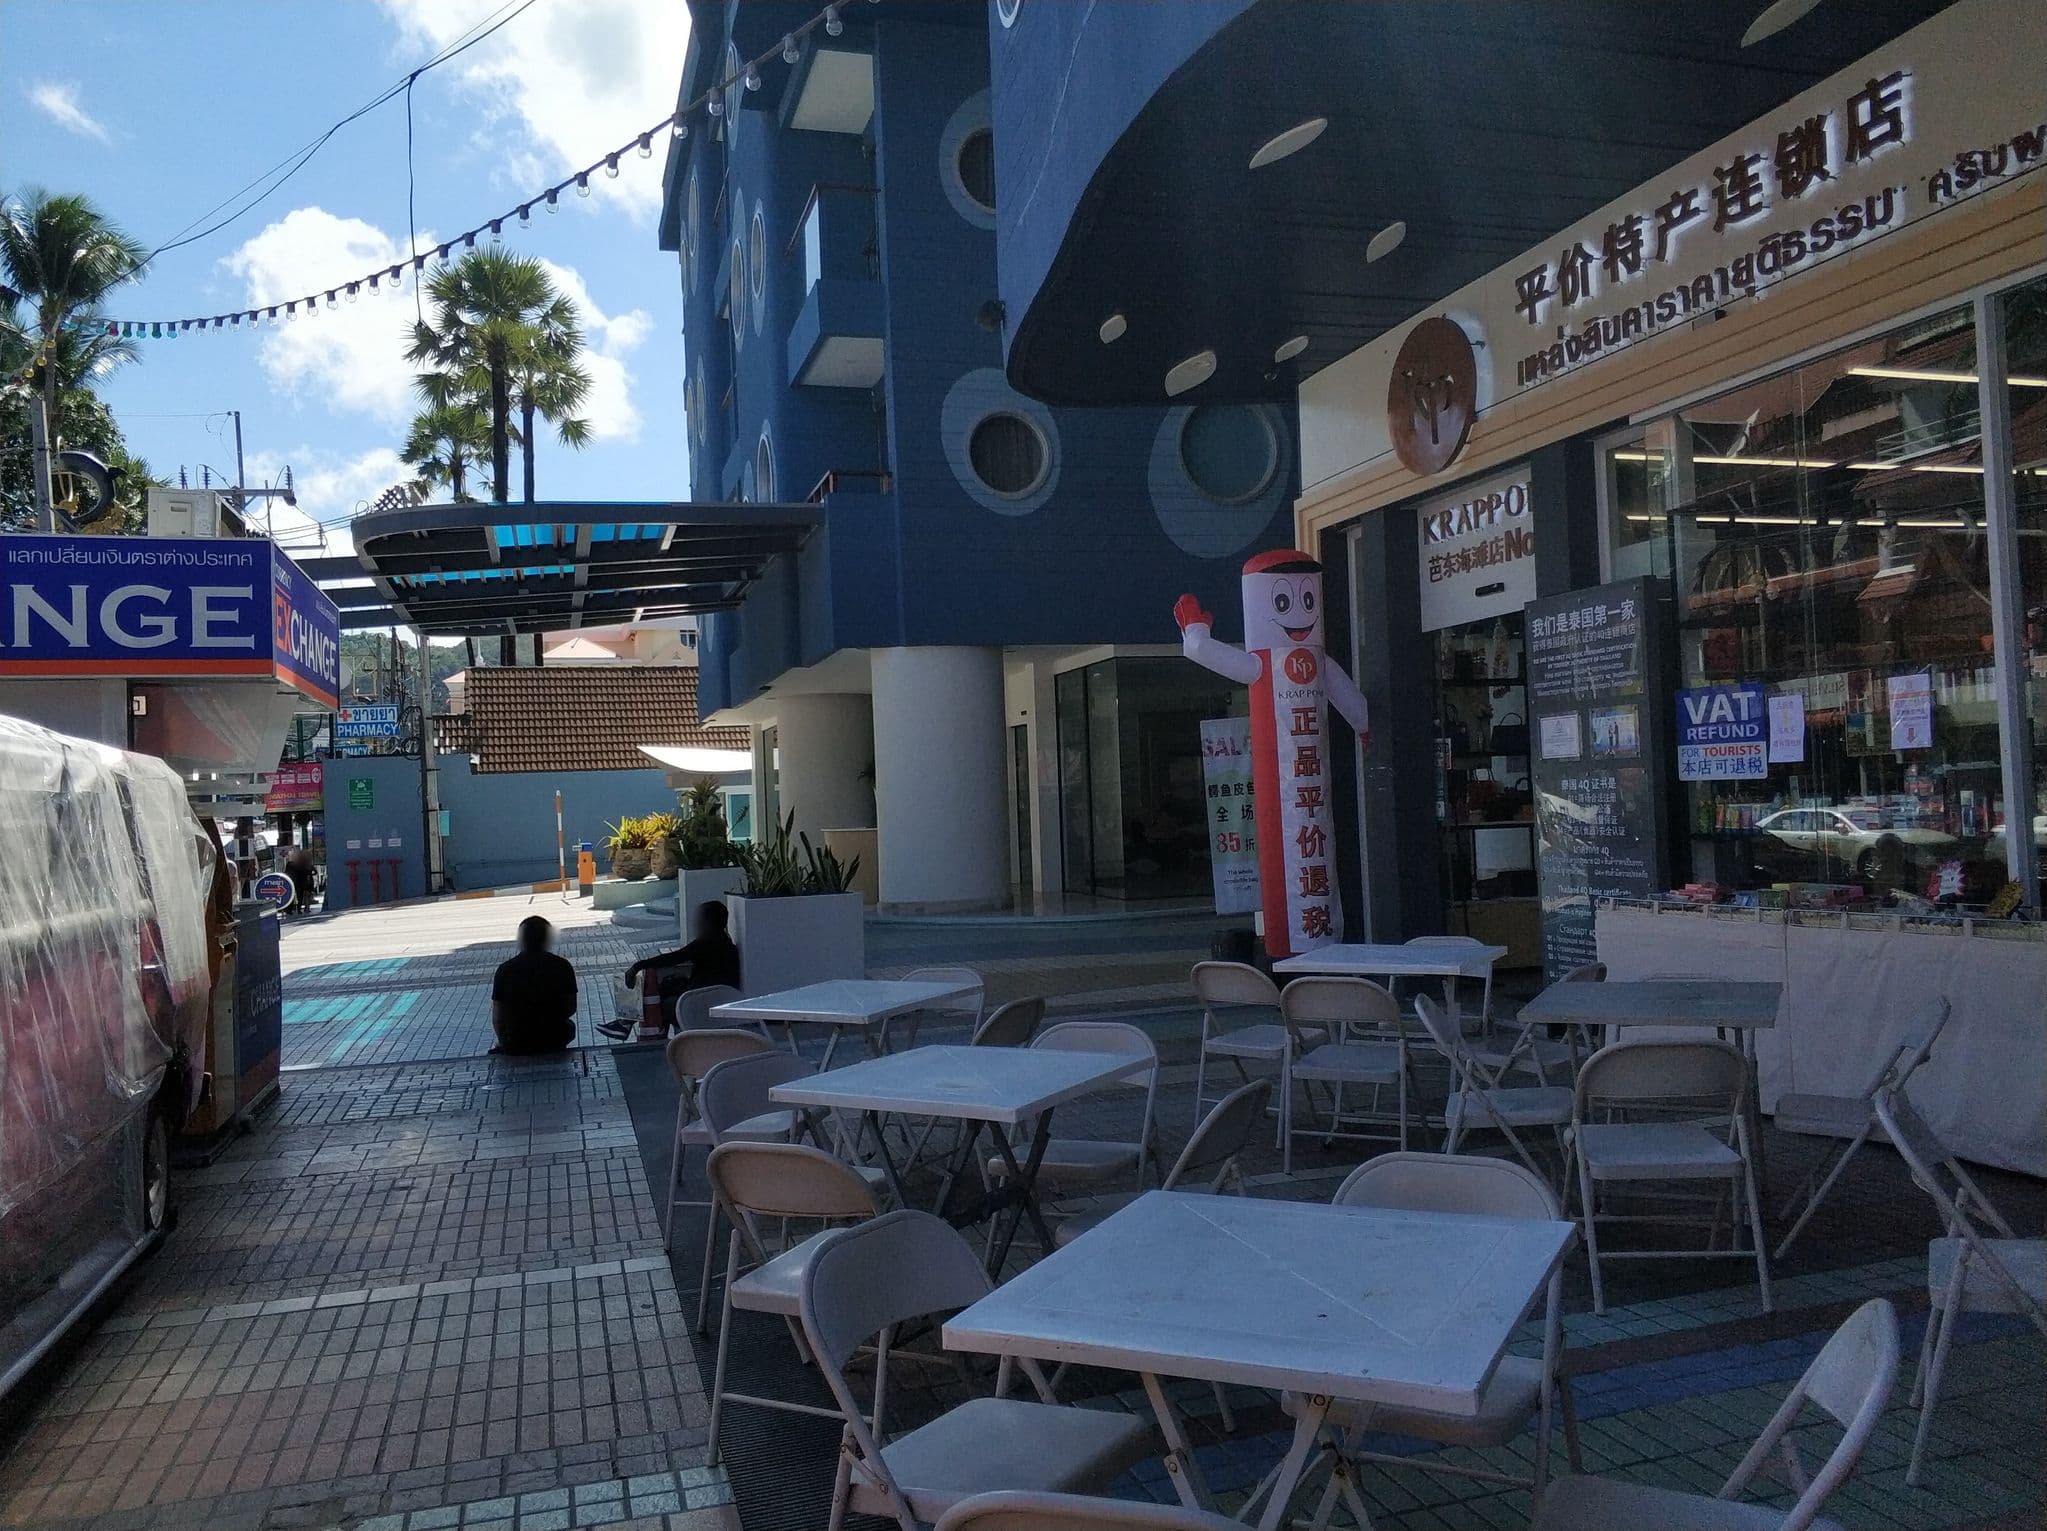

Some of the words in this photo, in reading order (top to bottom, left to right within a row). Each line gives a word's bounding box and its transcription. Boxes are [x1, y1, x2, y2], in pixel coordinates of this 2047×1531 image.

[1515, 71, 1907, 324] 平价特产连锁店
[8, 545, 253, 568] แลกเปลี่ยนเงินตราต่างประเทศ
[0, 583, 255, 650] NGE
[1532, 599, 1636, 637] 我们是泰国第一家
[276, 593, 337, 685] EXCHANGE
[353, 708, 396, 722] ขายยา
[1683, 691, 1756, 725] VAT
[337, 723, 398, 737] PHARMACY
[1687, 724, 1759, 740] REFUND
[1681, 748, 1699, 758] FOR
[1703, 745, 1761, 757] TOURISTS
[1682, 757, 1763, 776] 本店可退税
[1290, 706, 1334, 939] 正品平价退税
